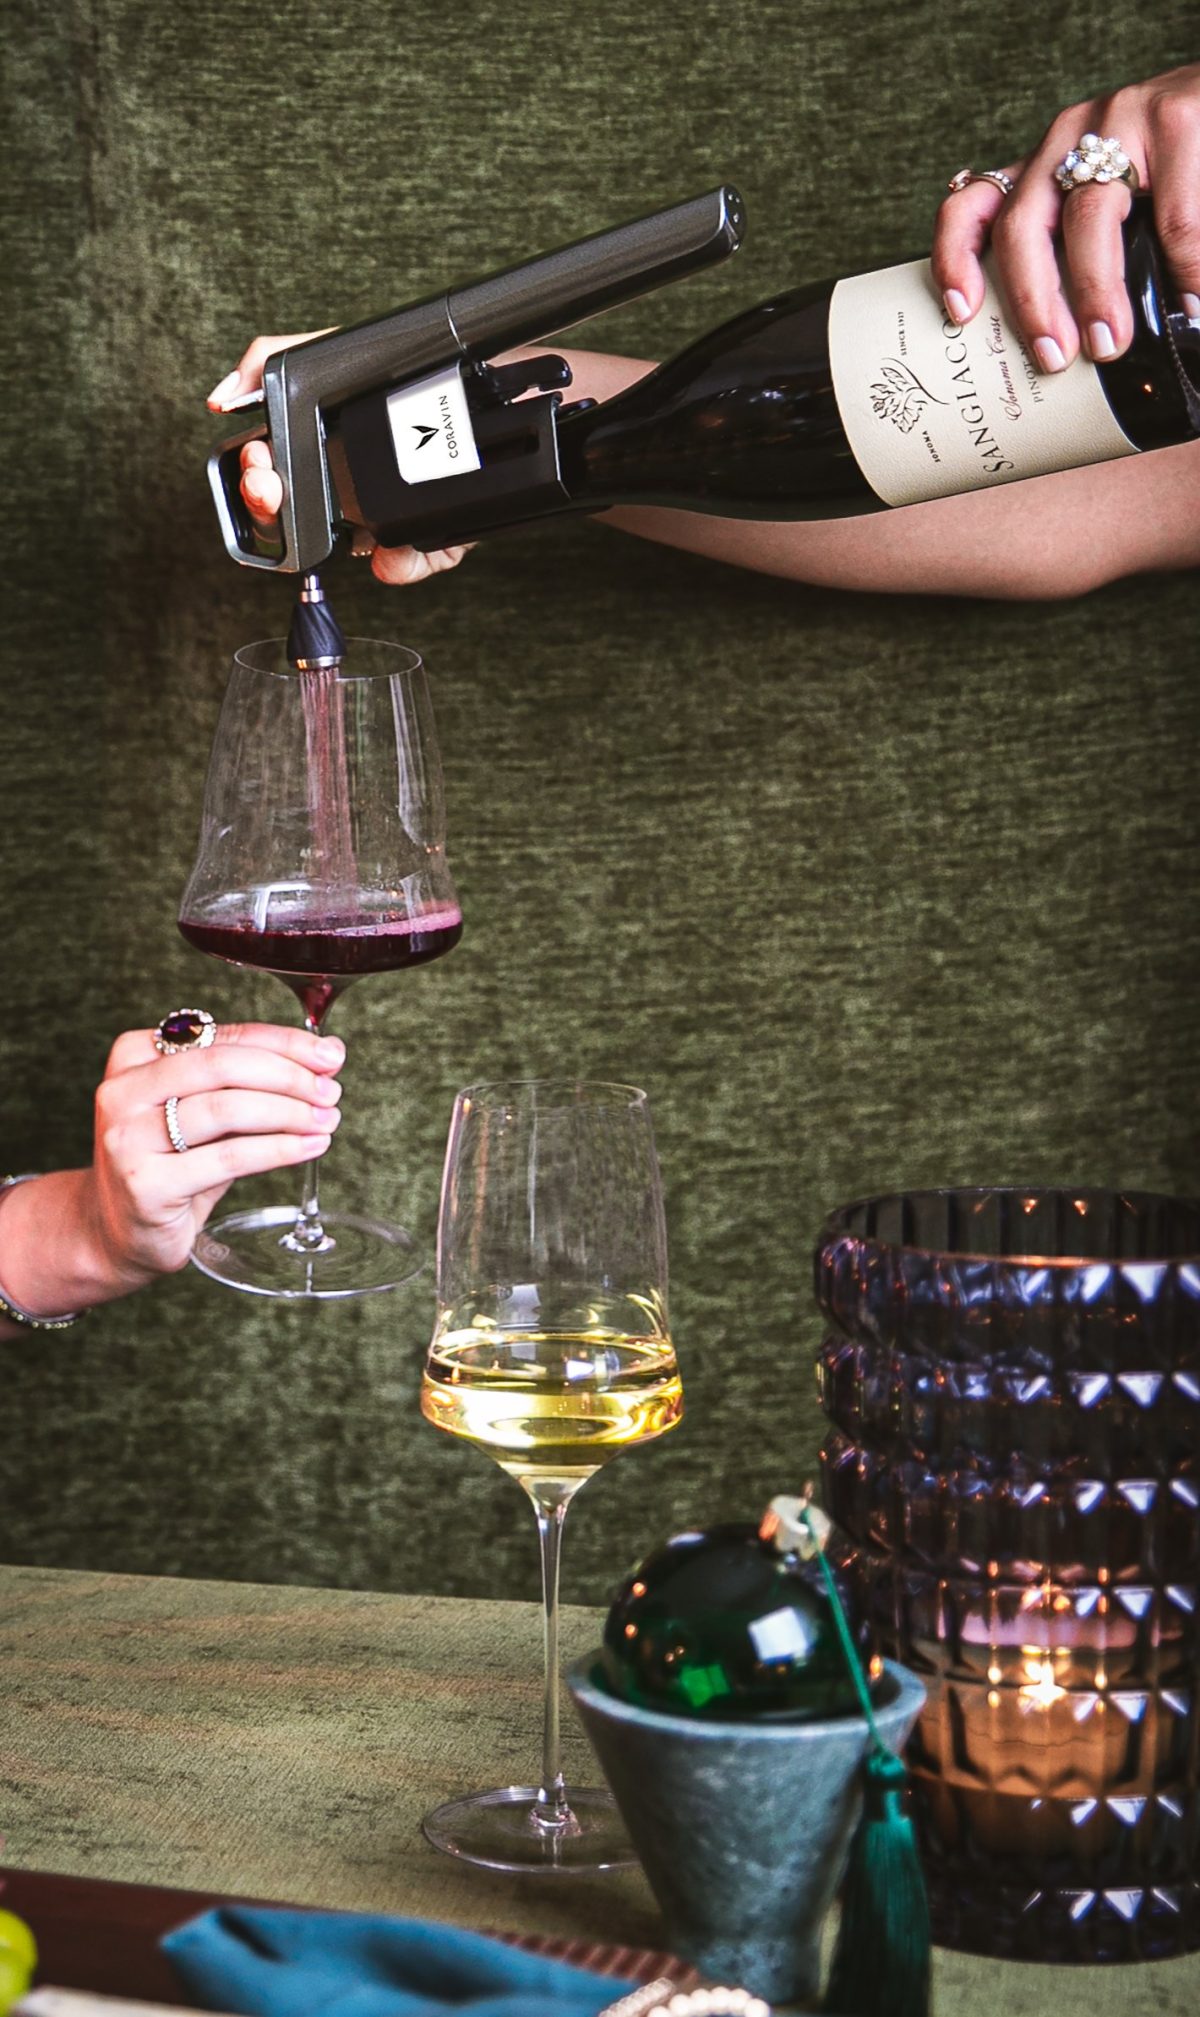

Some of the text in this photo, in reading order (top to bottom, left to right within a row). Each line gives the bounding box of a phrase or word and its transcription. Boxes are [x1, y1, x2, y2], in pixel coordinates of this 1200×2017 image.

[898, 329, 907, 356] SINCE
[986, 315, 1022, 421] Sonoma Coast
[941, 307, 1014, 473] SANGIACO
[1023, 361, 1044, 403] PINOT
[438, 395, 459, 459] CORAVIN
[922, 430, 941, 463] SONOMA
